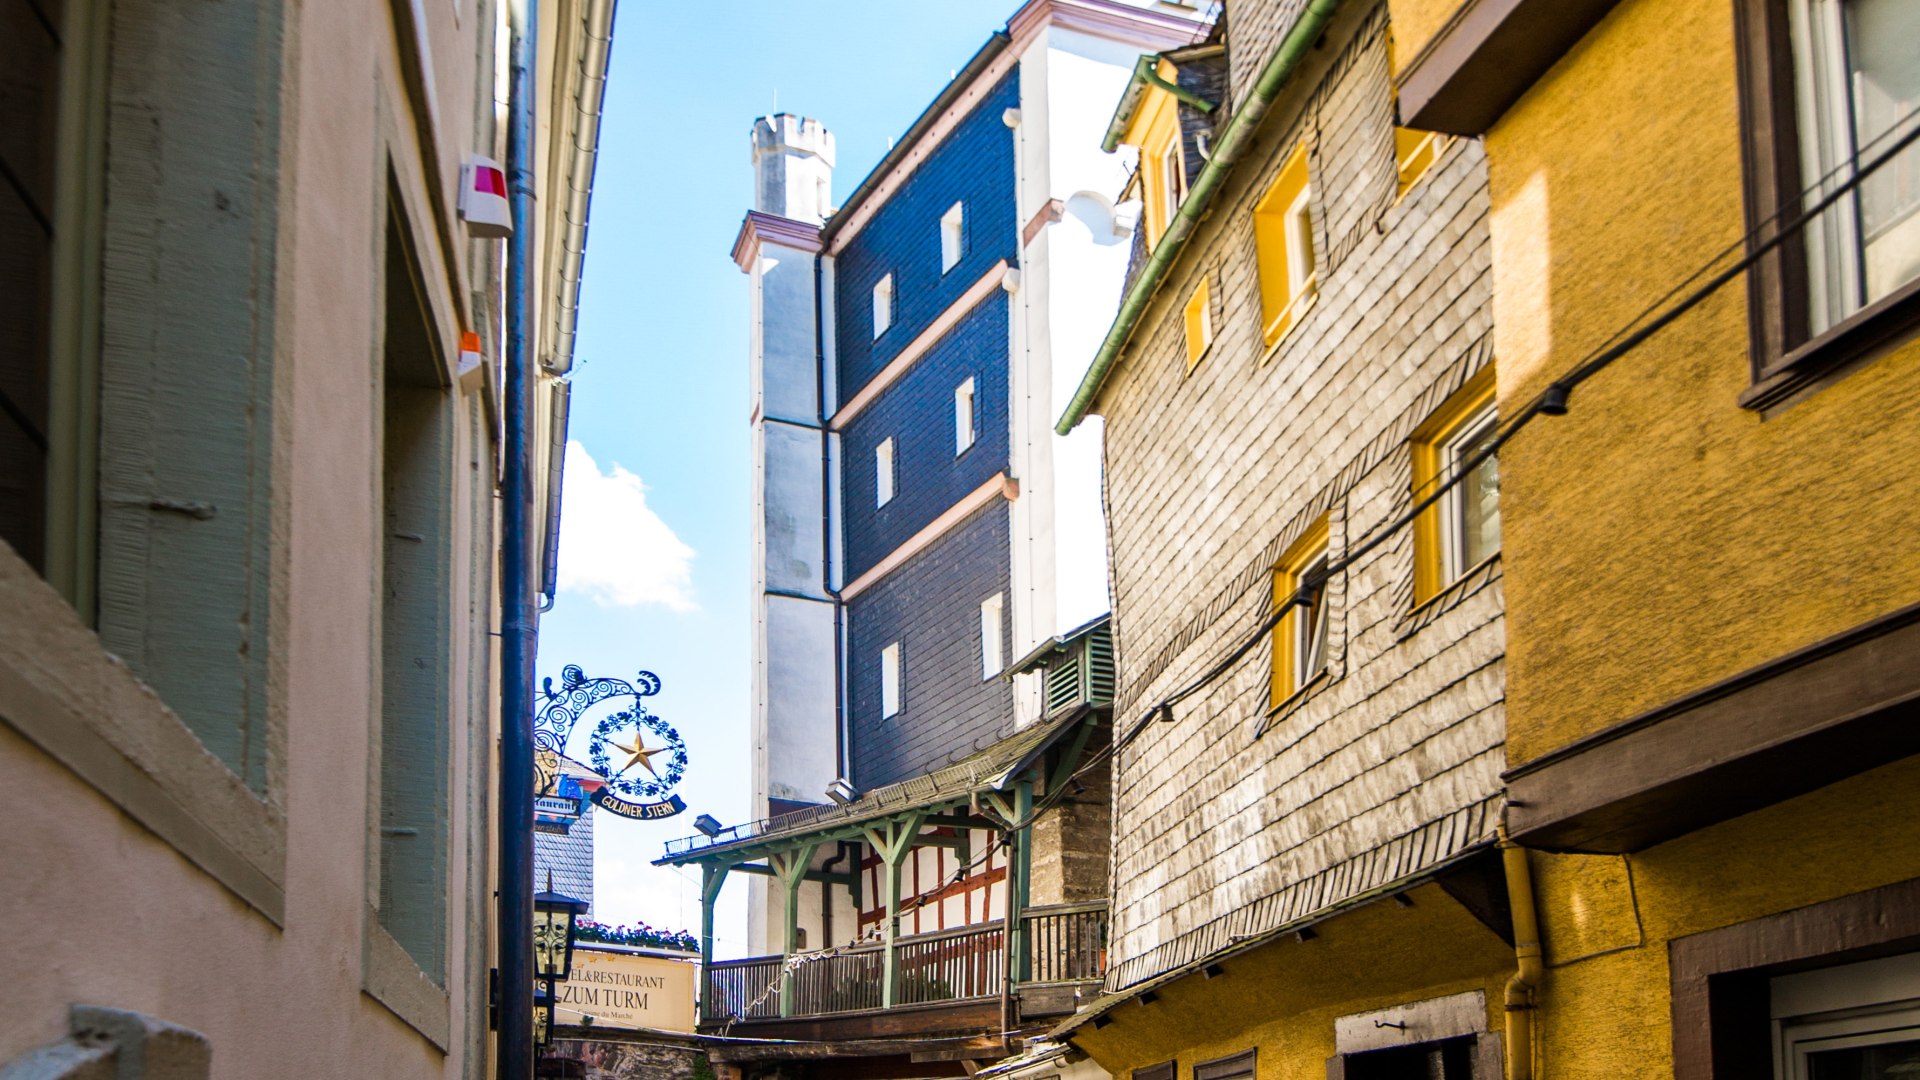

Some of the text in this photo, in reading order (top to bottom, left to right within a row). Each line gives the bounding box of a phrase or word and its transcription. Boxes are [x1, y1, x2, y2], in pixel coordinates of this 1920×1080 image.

[601, 795, 676, 818] GOLDNER STERN
[563, 985, 649, 1010] ZUM TURM
